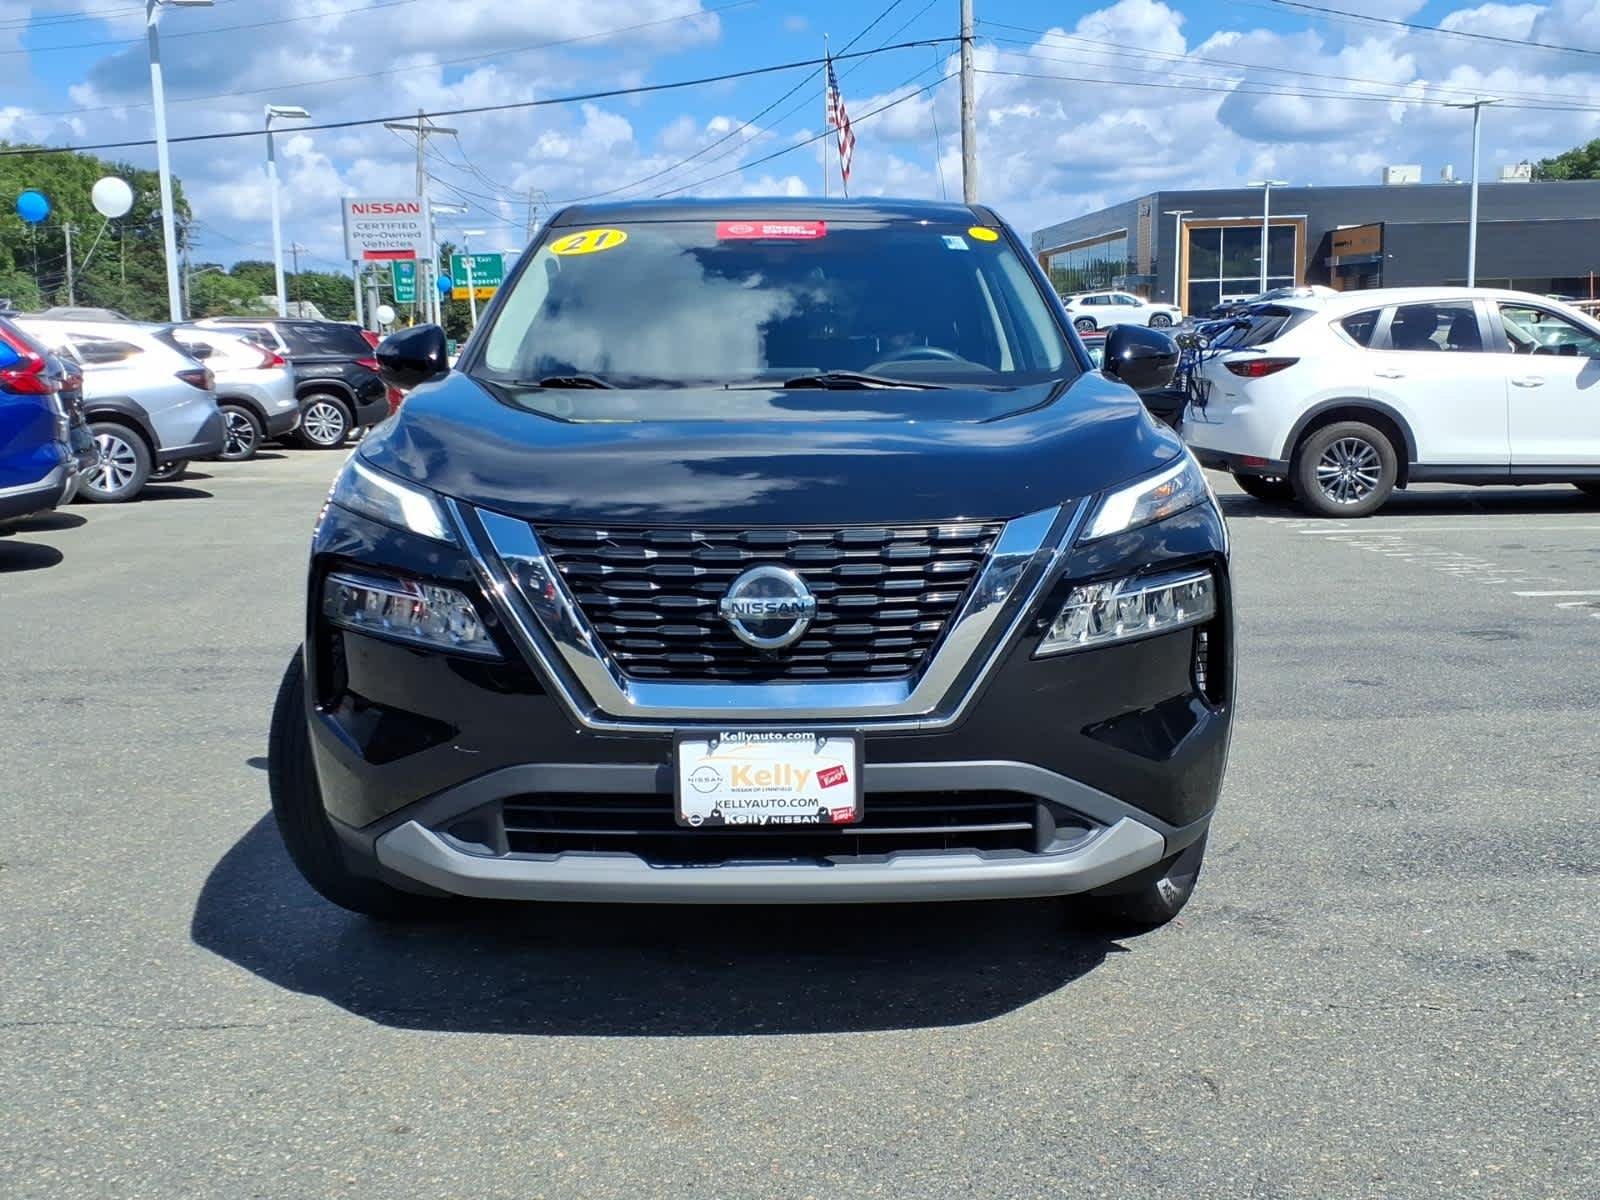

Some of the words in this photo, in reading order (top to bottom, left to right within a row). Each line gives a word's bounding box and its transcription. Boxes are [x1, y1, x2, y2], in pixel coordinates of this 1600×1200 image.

[351, 203, 420, 214] NISSAN
[355, 222, 417, 230] CERTIFIED
[352, 231, 422, 239] Pre-Owned
[361, 240, 413, 248] Vehicles
[561, 231, 610, 252] 21
[731, 602, 805, 614] NISSAN
[719, 731, 816, 745] Kellyauto.com
[731, 764, 811, 792] Kelly
[715, 798, 819, 809] KELLYAUTO.COM
[724, 814, 769, 825] Kelly
[771, 815, 820, 824] NISSAN
